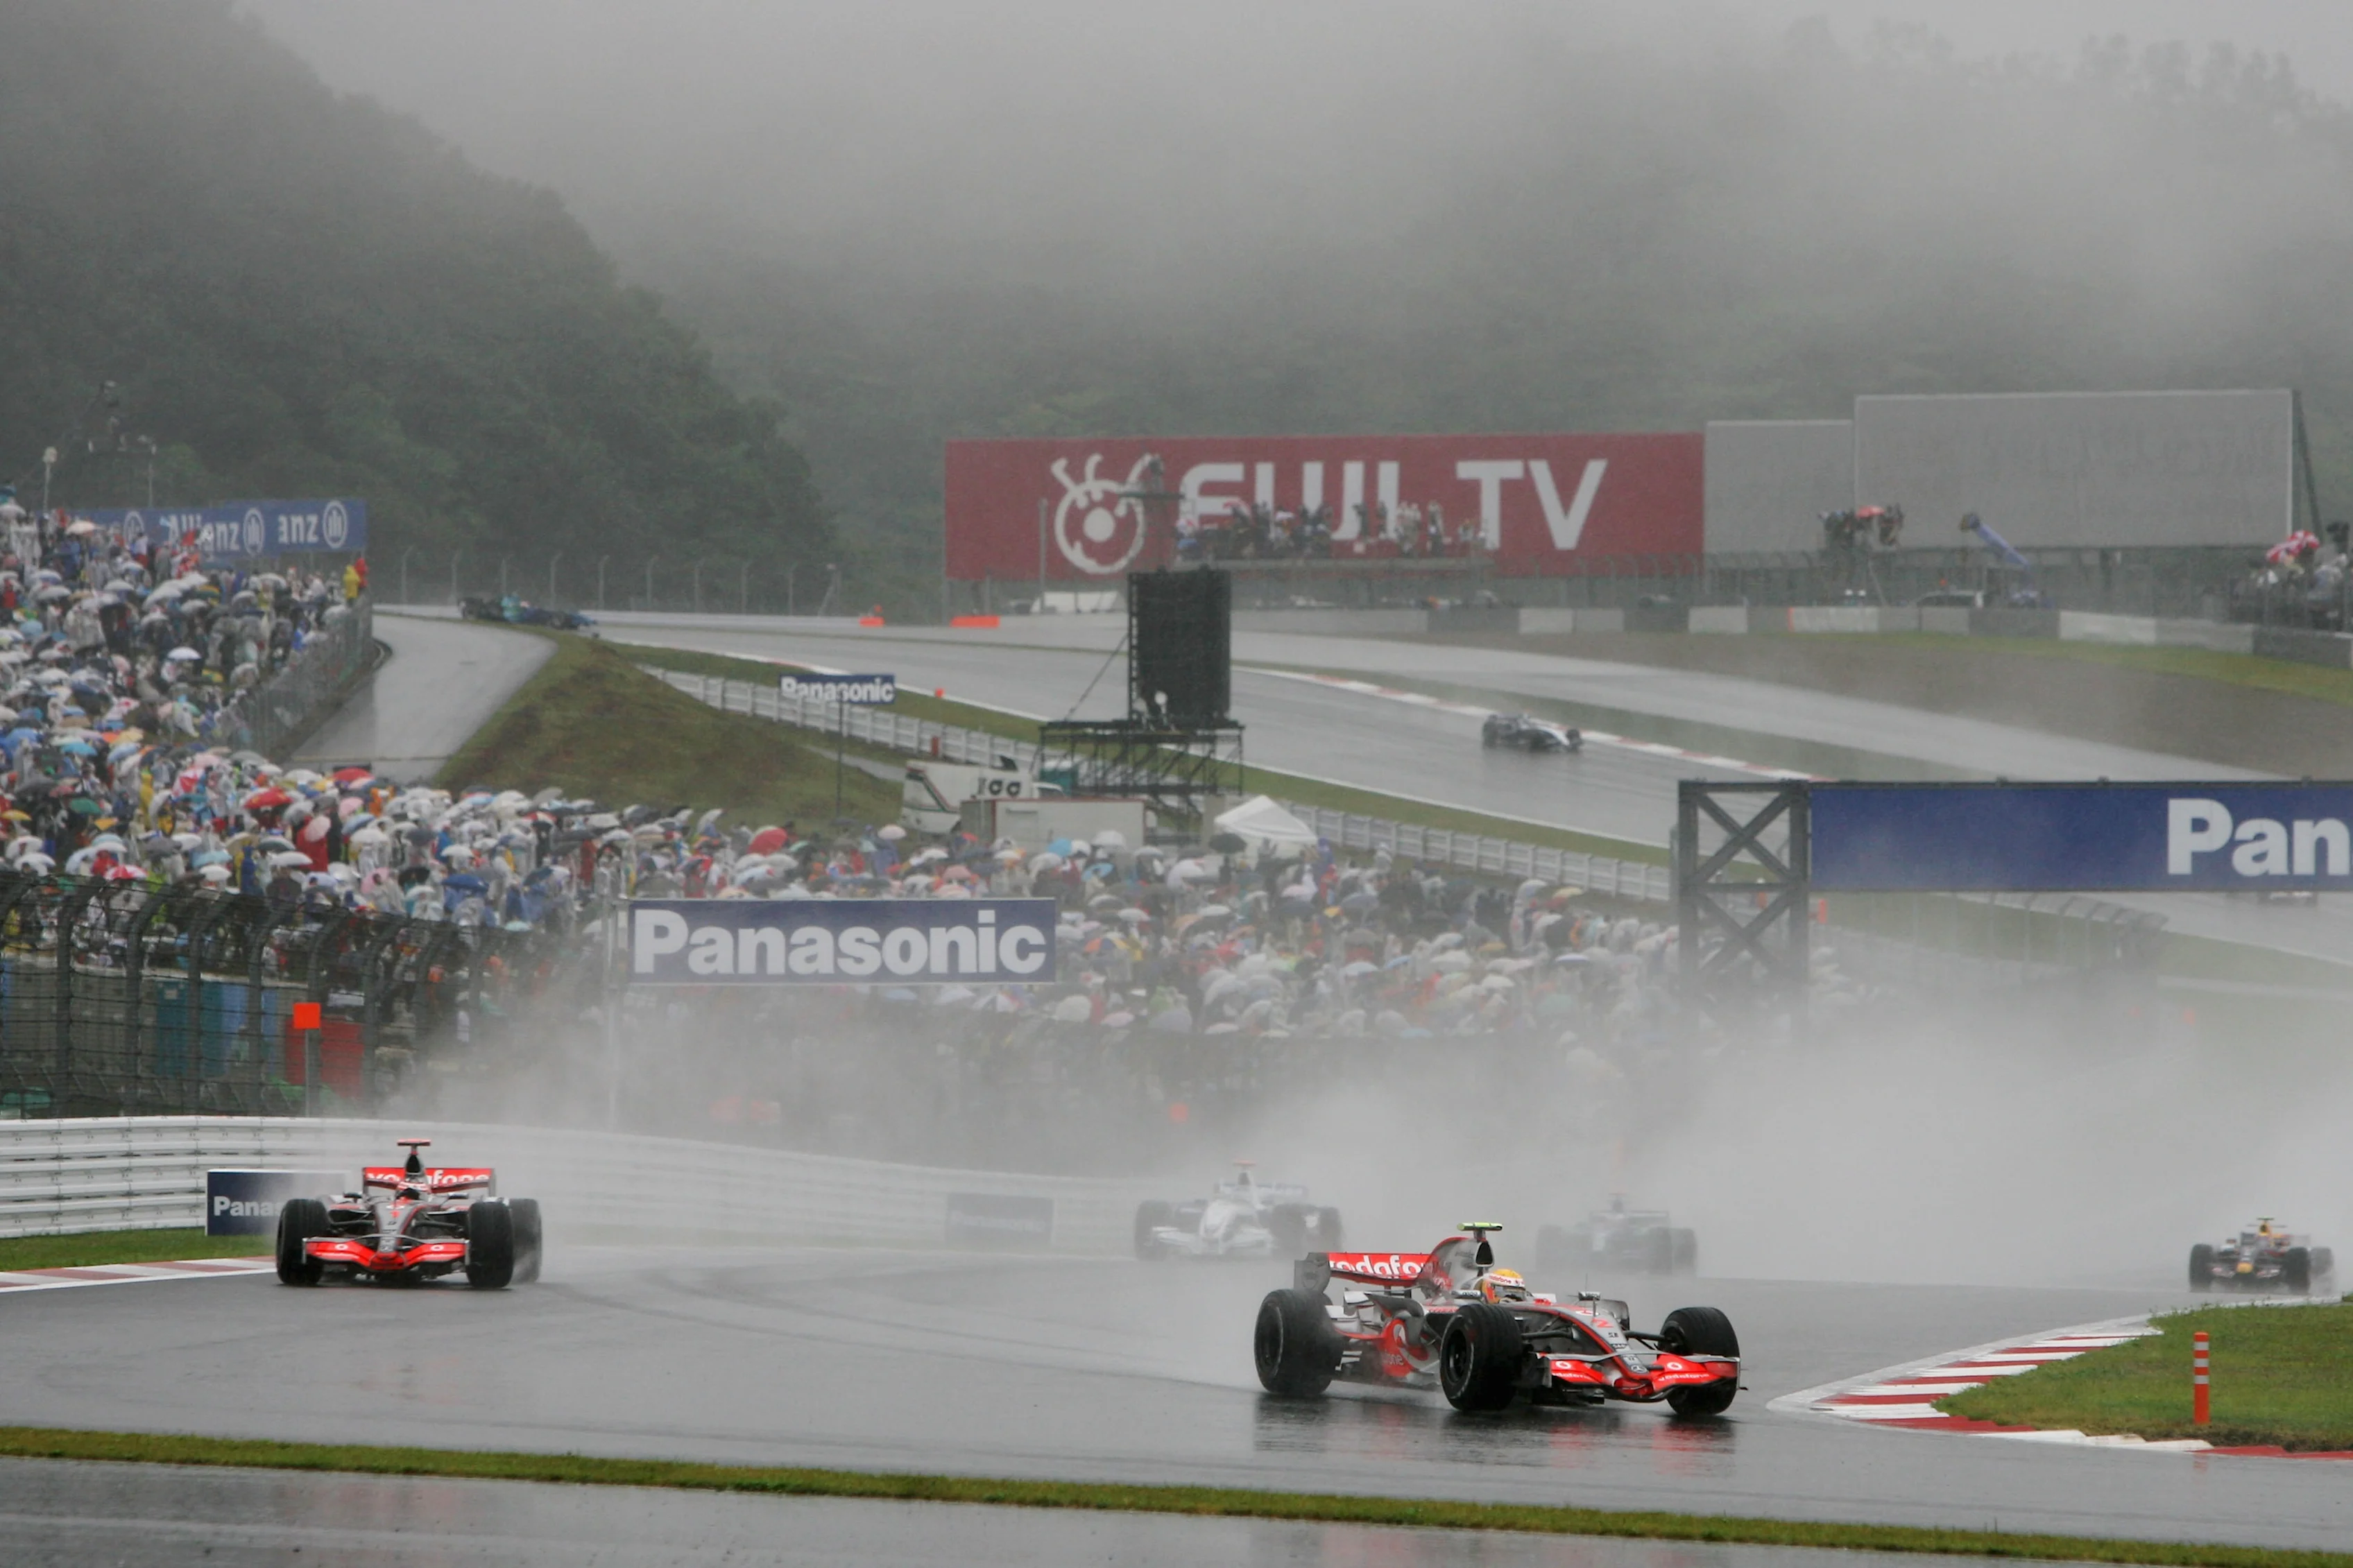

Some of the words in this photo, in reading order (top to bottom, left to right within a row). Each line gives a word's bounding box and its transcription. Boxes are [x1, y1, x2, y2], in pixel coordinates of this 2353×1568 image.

[1457, 459, 1607, 550] TV
[780, 676, 894, 703] Panasonic
[2167, 798, 2351, 877] Pan
[634, 908, 1046, 974] Panasonic
[366, 1169, 489, 1187] vofone
